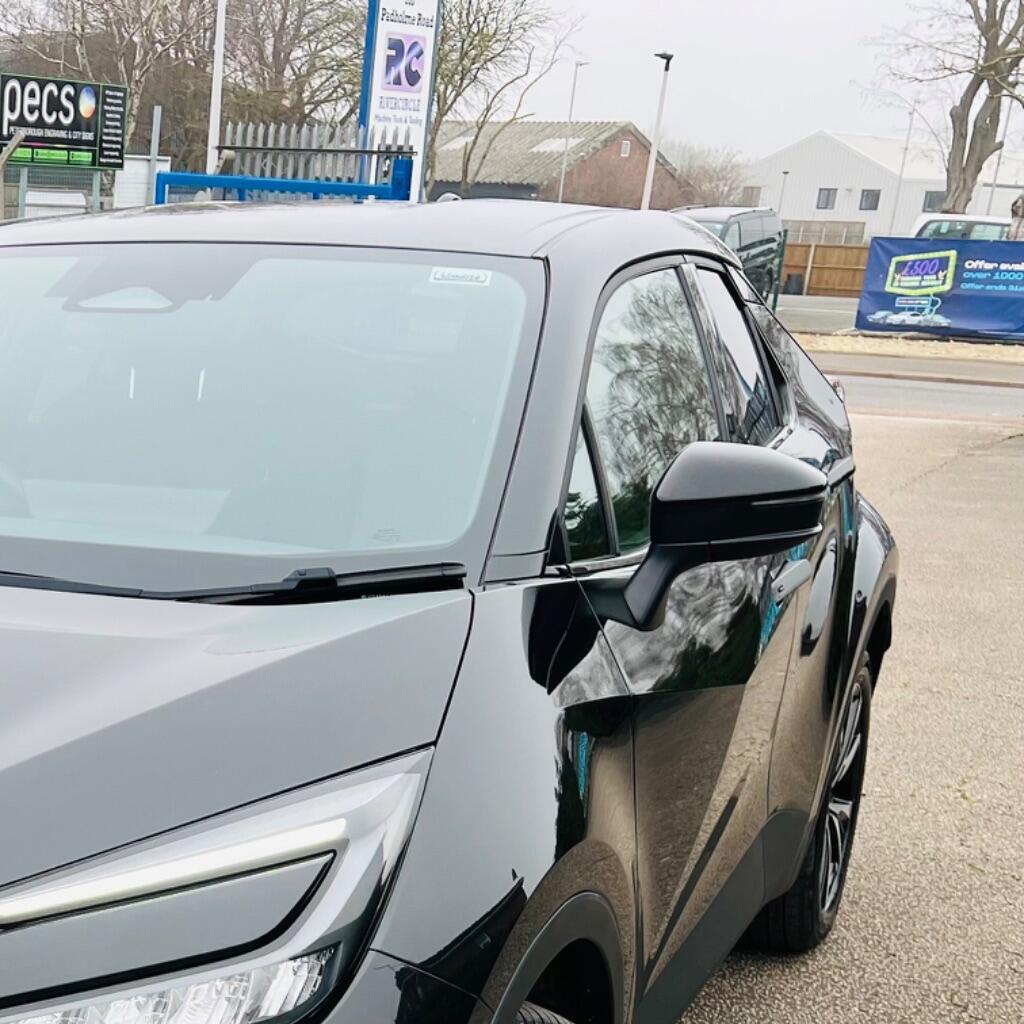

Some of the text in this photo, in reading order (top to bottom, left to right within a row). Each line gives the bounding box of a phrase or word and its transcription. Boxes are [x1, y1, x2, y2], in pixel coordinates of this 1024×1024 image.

[381, 7, 433, 28] Padholme Road
[385, 37, 424, 87] RC
[2, 78, 76, 137] pecs
[901, 258, 940, 276] £500
[964, 259, 998, 270] Offer
[963, 271, 1024, 280] over 1000
[960, 282, 985, 290] Offer
